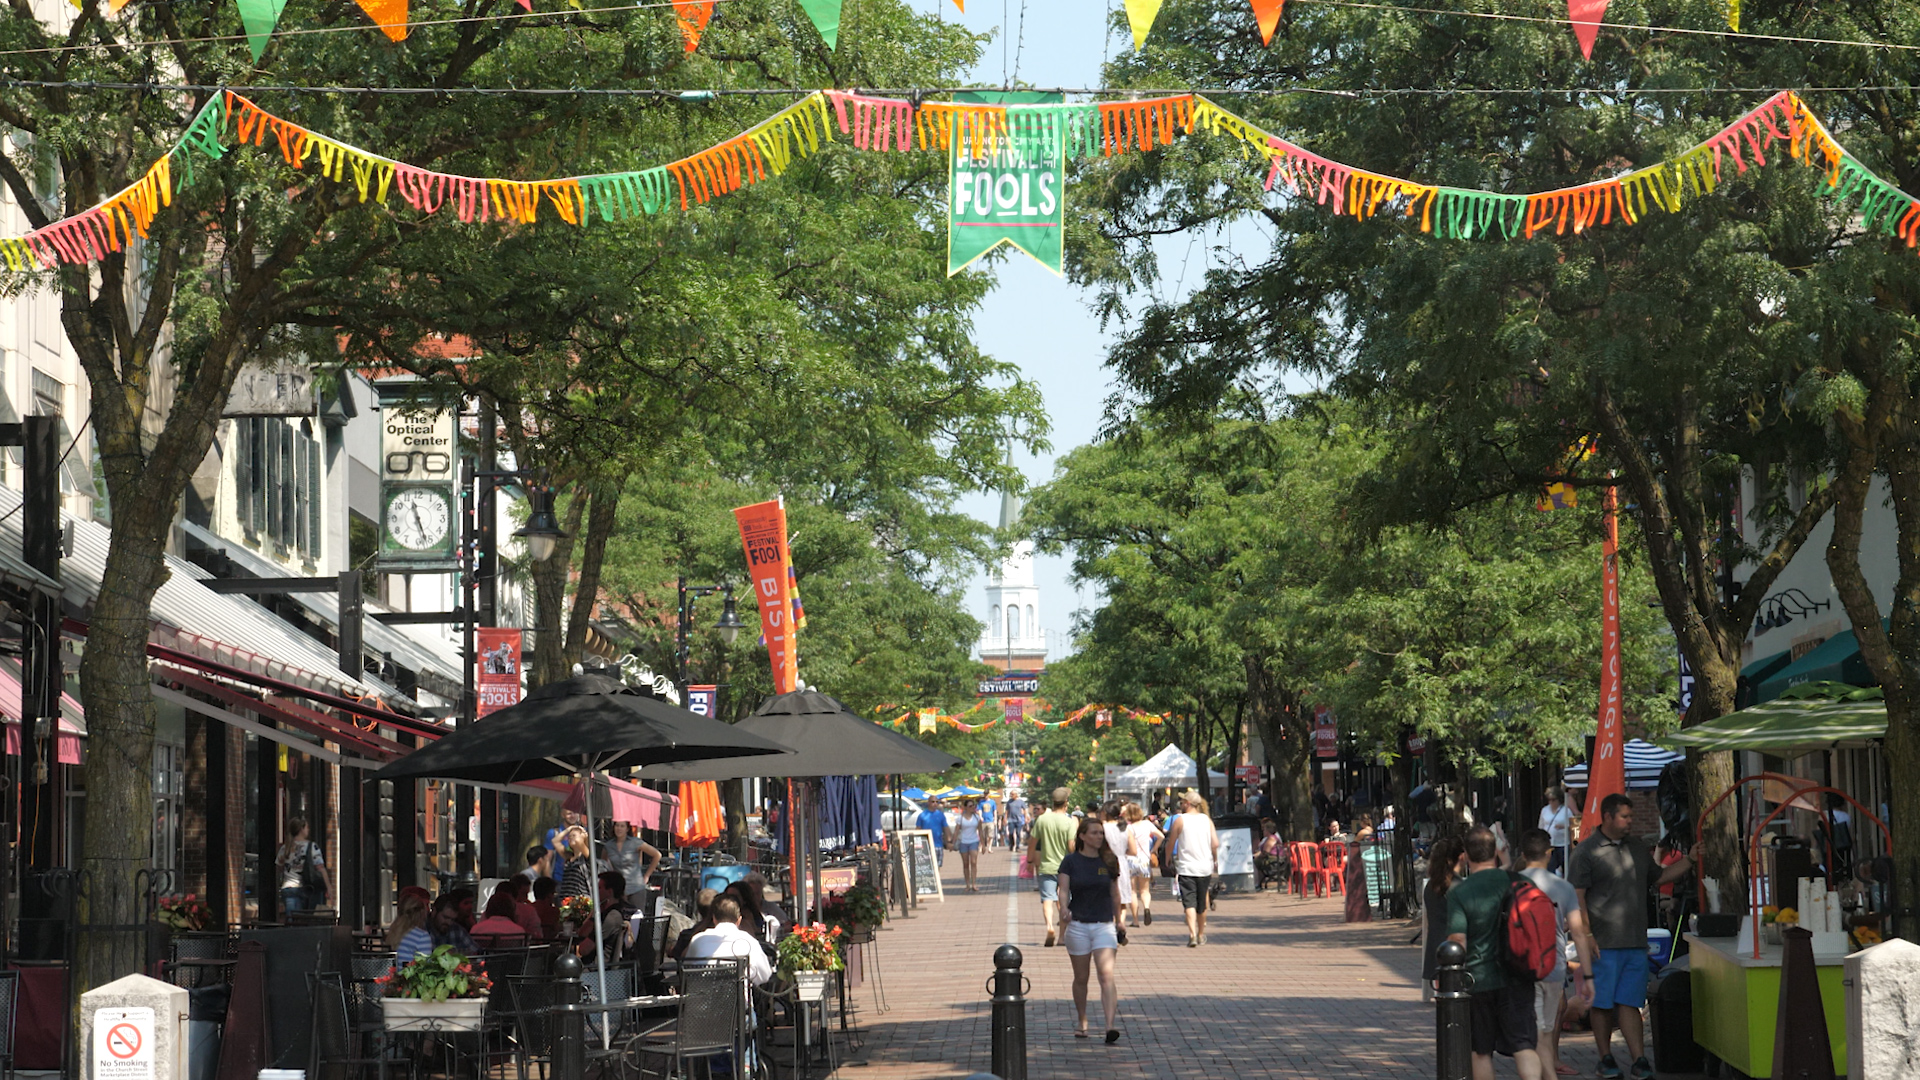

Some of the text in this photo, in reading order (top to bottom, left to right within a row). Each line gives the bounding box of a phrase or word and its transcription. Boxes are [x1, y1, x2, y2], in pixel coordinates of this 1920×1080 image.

[956, 147, 1039, 168] FESTIVAL
[955, 171, 1056, 216] FOOLS
[403, 413, 427, 424] The
[386, 424, 434, 436] Optical
[403, 436, 449, 446] Center
[747, 536, 780, 549] FESTIVAL
[479, 693, 518, 706] FOOLS
[114, 1060, 148, 1068] Smoking
